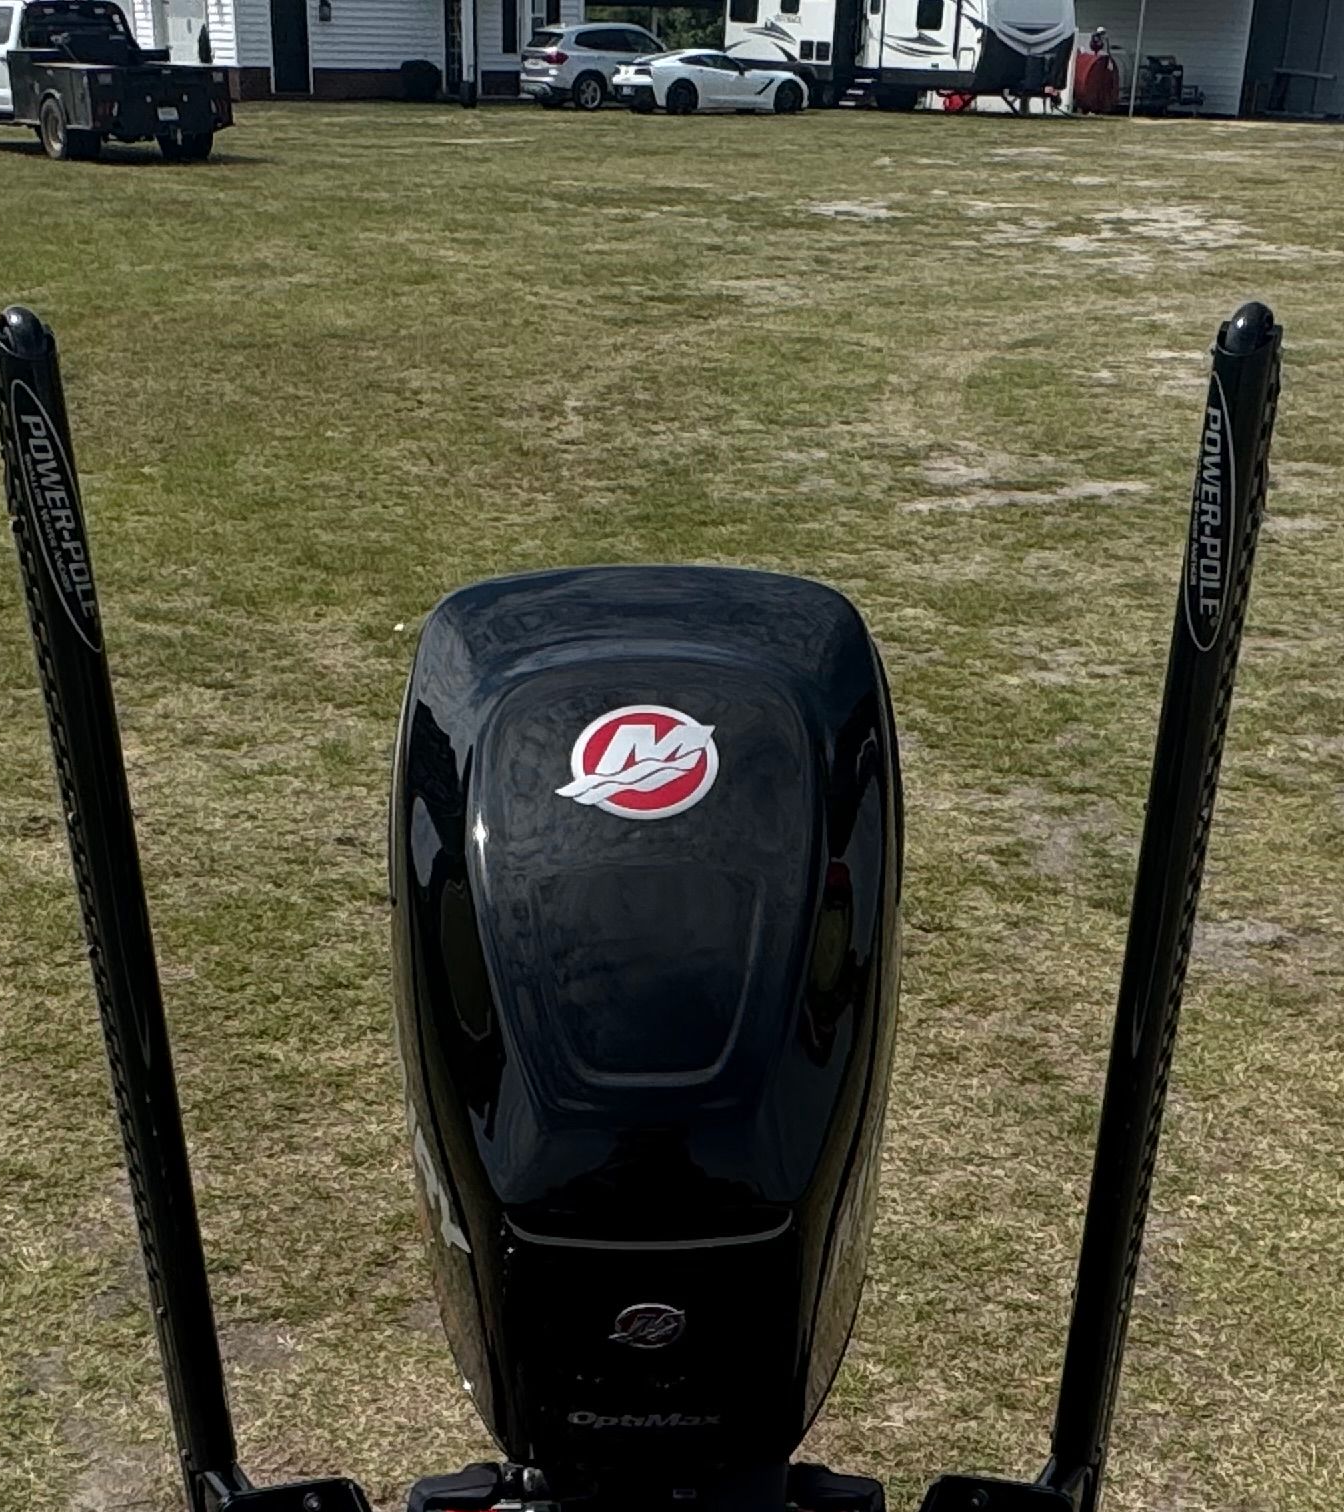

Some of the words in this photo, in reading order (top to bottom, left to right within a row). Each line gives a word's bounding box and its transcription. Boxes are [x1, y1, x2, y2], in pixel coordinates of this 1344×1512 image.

[21, 415, 97, 617] POWER-POLE
[1199, 406, 1222, 616] POWER-POLE
[566, 1410, 722, 1430] OptiMax
